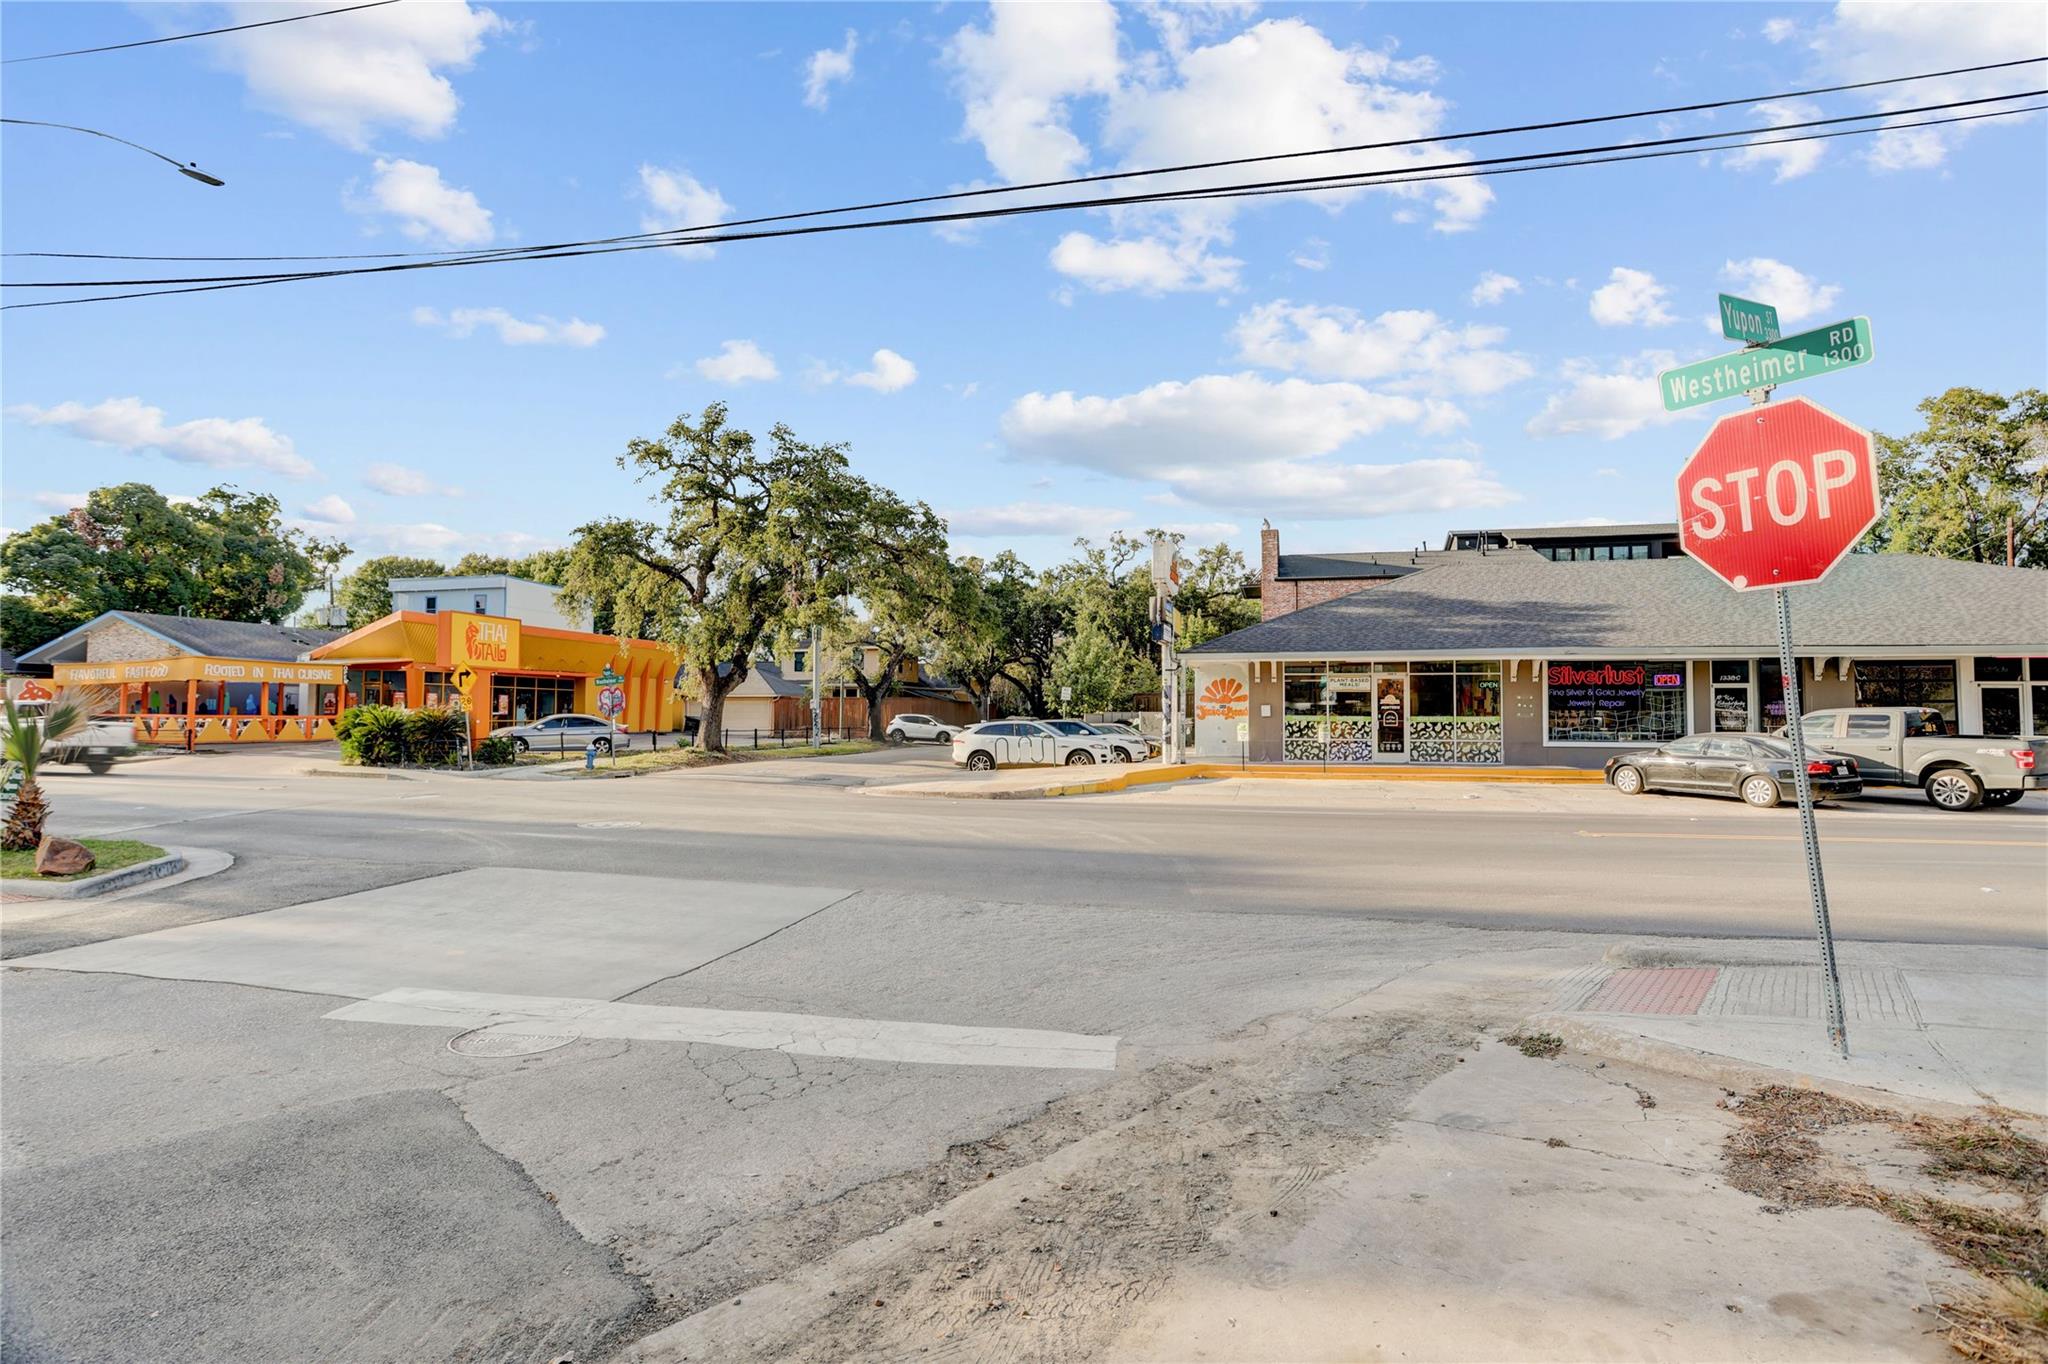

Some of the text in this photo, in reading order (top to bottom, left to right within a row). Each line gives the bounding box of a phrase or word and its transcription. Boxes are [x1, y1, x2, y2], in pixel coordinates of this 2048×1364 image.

[1721, 301, 1764, 338] Yupon
[1765, 311, 1774, 325] ST
[1829, 326, 1854, 346] RD
[1823, 343, 1864, 367] 1300
[1670, 349, 1808, 404] Westheimer
[1691, 449, 1857, 540] STOP
[204, 663, 246, 678] ROOTED
[252, 667, 264, 679] IN
[271, 667, 294, 679] THAI
[297, 668, 334, 681] CUISINE
[1548, 664, 1646, 686] Silverlust
[1655, 675, 1678, 685] OPEN
[1480, 681, 1498, 689] OPEN
[1548, 689, 1565, 697] Fine
[1565, 688, 1586, 697] Silver
[1595, 688, 1616, 697] Gold
[1617, 688, 1646, 699] Jewelry
[1566, 699, 1626, 709] Jewelry Repair
